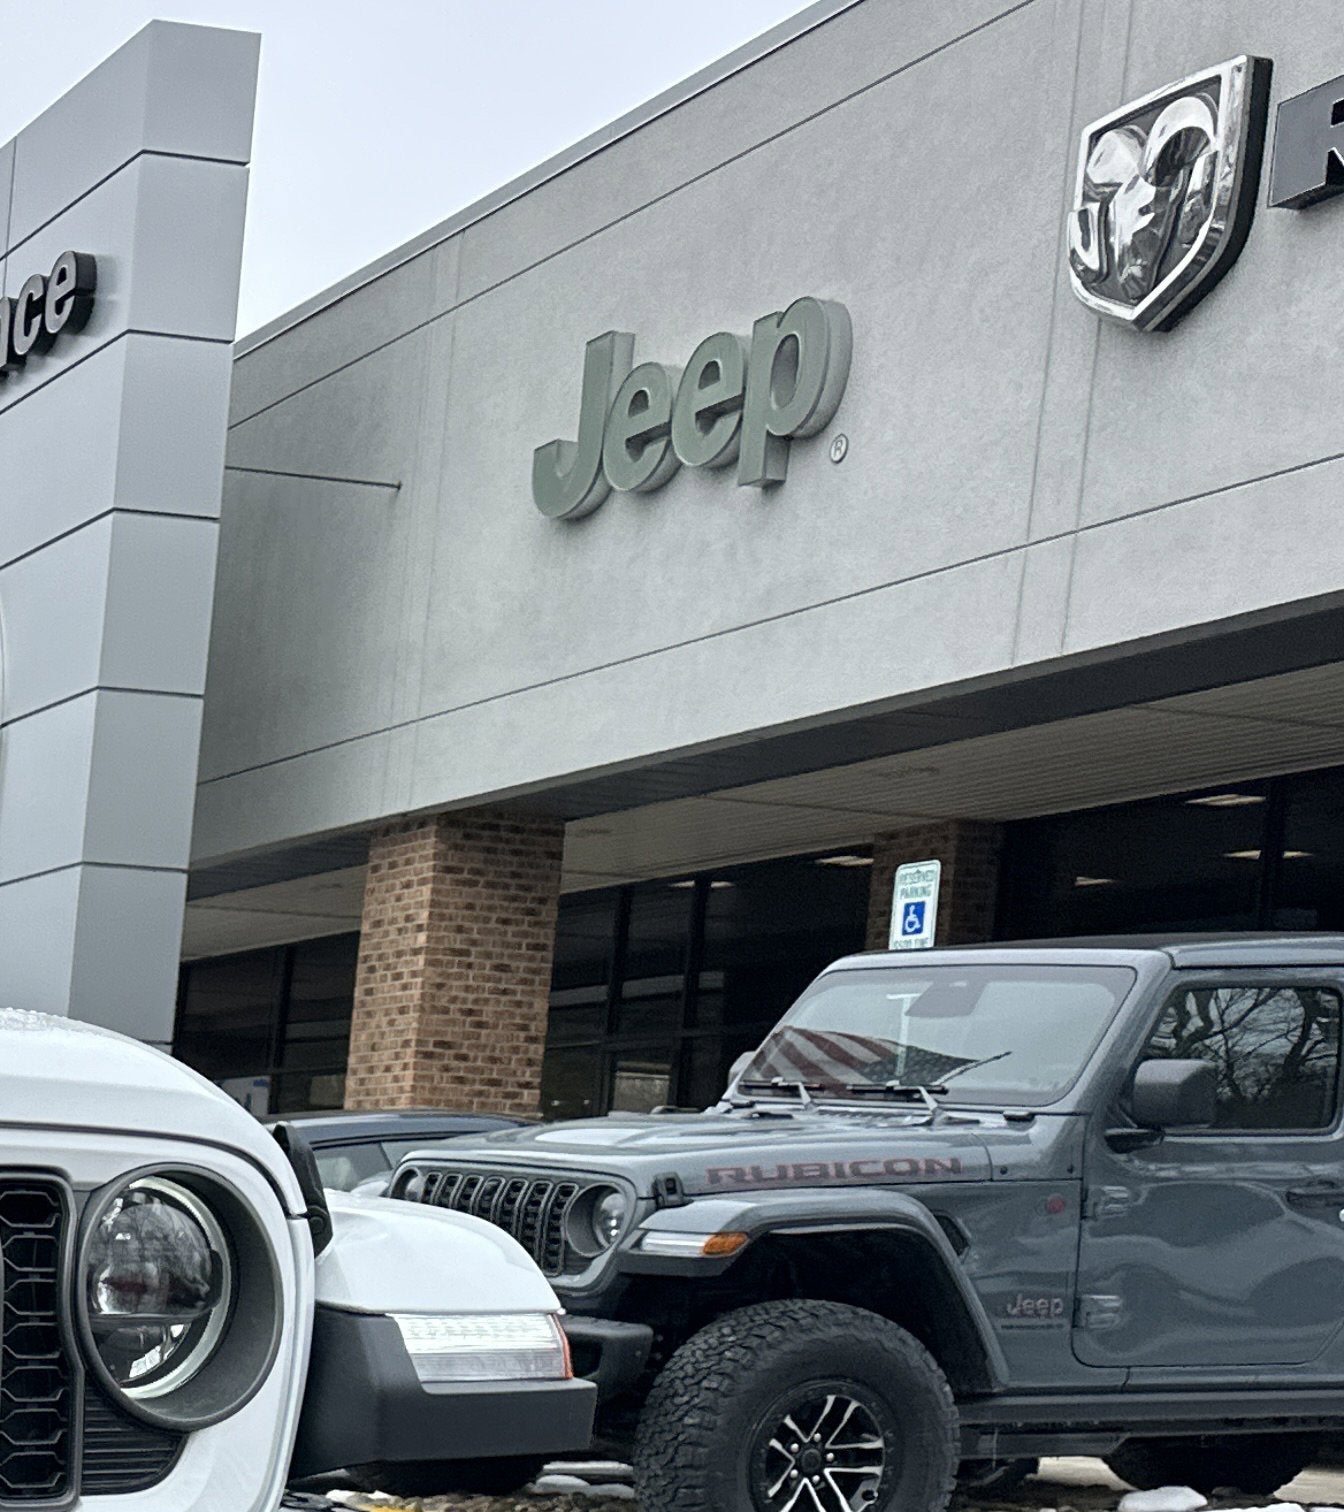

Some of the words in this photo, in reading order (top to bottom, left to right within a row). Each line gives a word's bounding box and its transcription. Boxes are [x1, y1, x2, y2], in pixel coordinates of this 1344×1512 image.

[531, 296, 853, 520] Jeep
[900, 885, 932, 900] PARKING
[705, 1157, 962, 1186] RUBICON
[1006, 1293, 1063, 1319] Jeep
